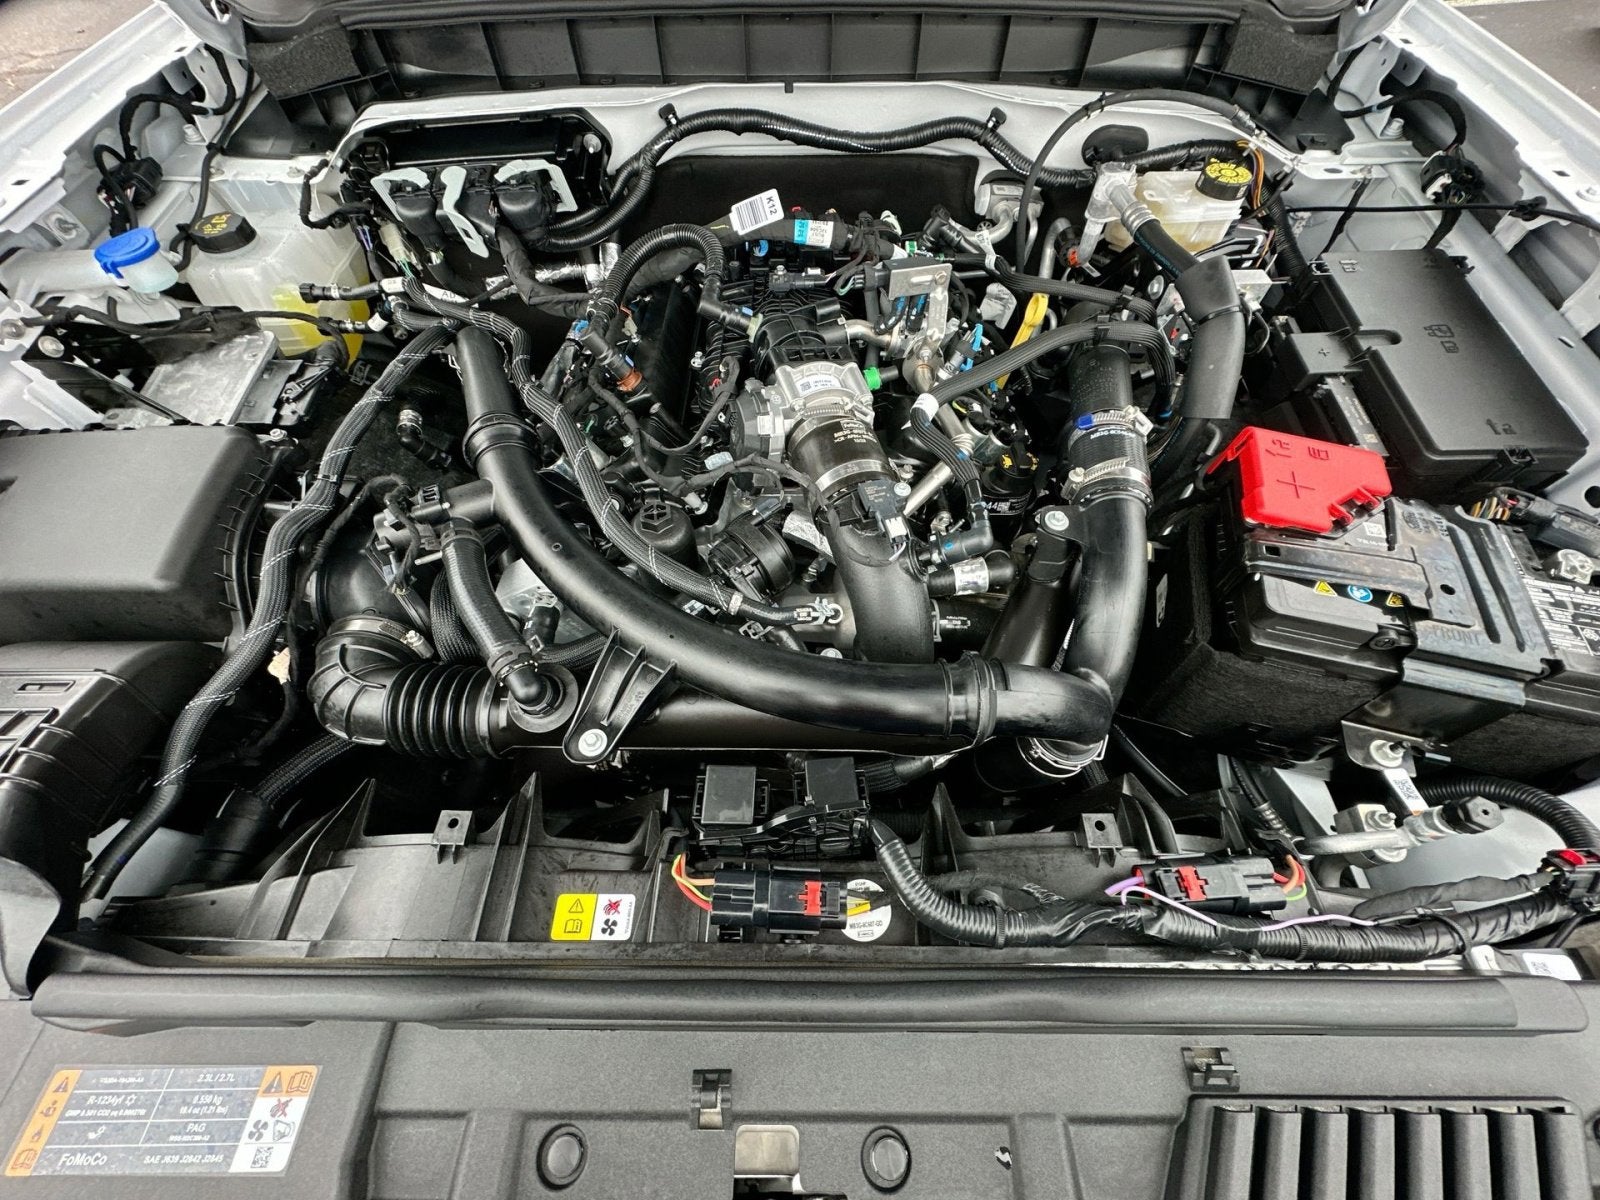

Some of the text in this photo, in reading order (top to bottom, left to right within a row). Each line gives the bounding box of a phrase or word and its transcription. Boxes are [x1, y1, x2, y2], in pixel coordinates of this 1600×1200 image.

[764, 196, 778, 217] K12
[441, 290, 456, 299] AD
[219, 1073, 235, 1082] 2.7L
[186, 1123, 206, 1133] PAG
[58, 1152, 107, 1166] FoMoCo
[143, 1155, 160, 1164] SAE
